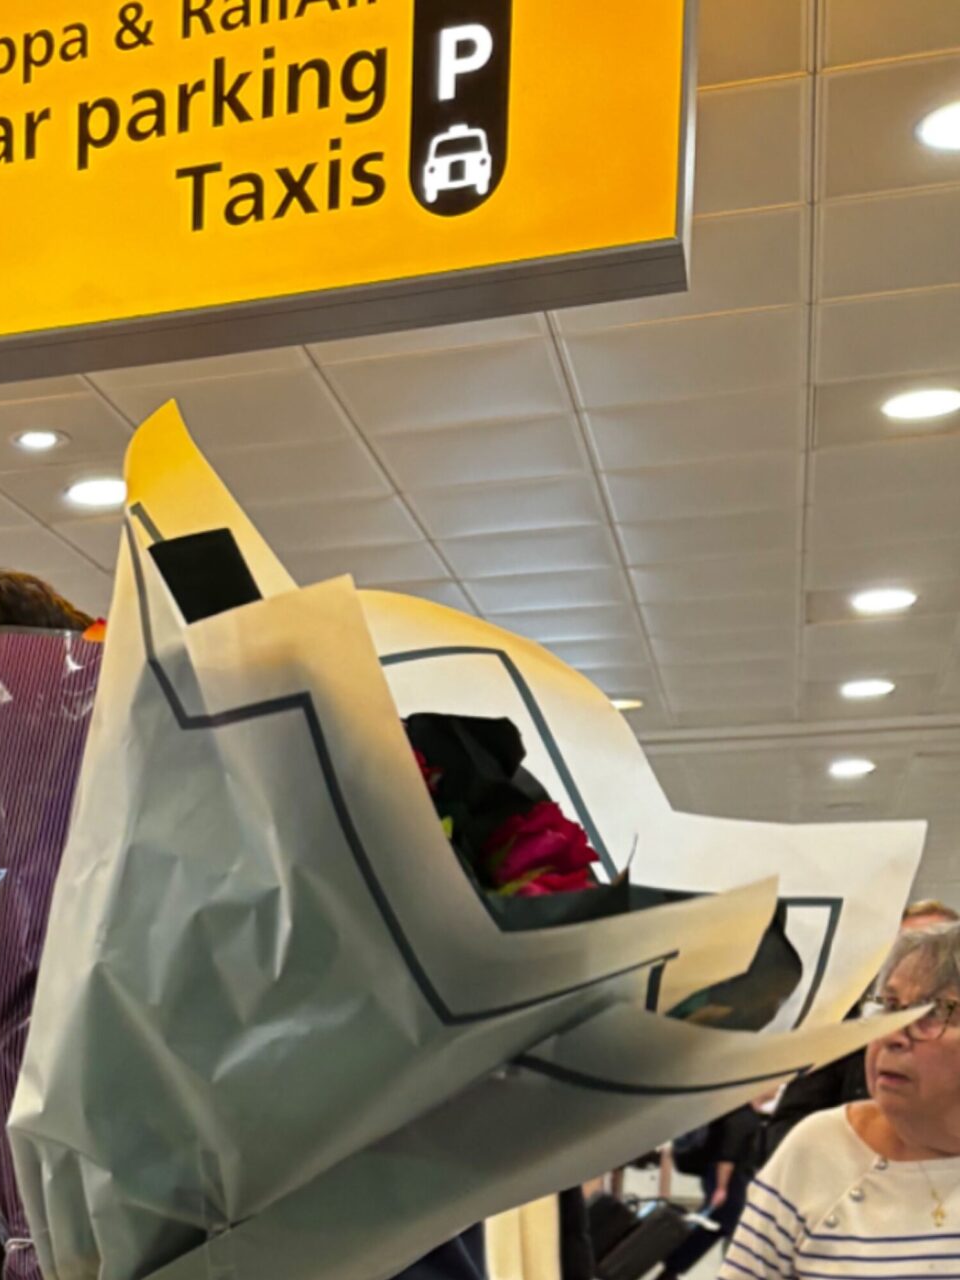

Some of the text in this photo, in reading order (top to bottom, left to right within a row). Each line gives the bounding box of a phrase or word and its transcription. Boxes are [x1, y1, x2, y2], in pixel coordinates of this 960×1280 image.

[114, 2, 154, 51] &
[77, 46, 388, 171] parking
[437, 23, 494, 101] P
[175, 137, 387, 232] Taxis
